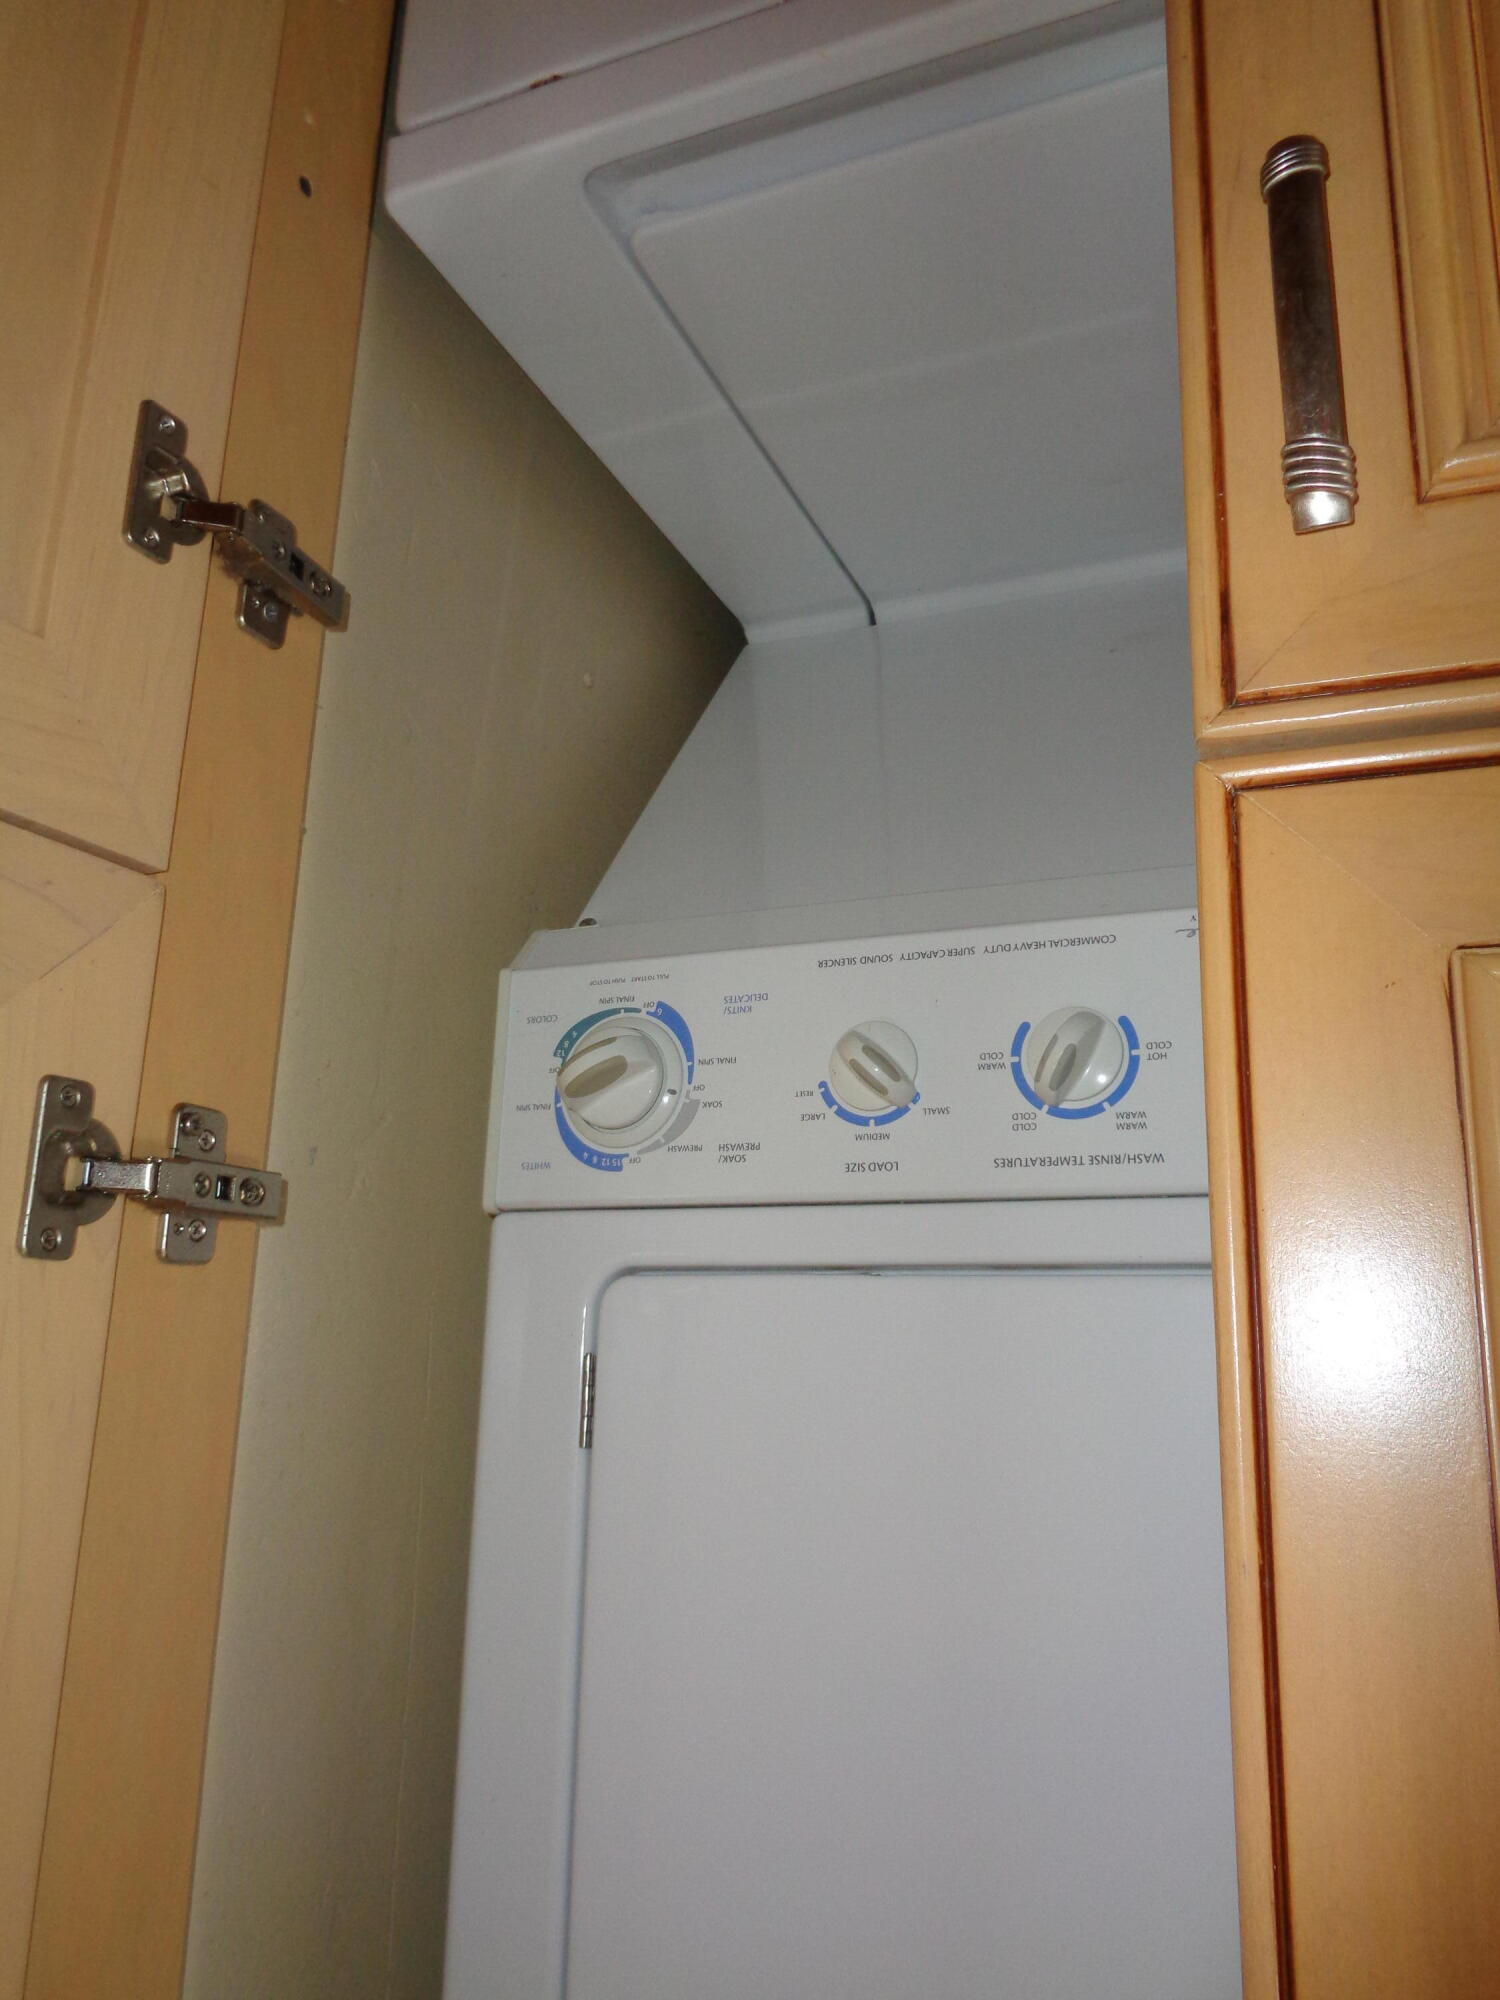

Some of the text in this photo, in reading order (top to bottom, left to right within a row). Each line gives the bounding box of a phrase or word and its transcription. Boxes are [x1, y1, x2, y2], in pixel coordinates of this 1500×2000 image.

[818, 934, 1117, 968] COMMERCIAL HEAVY DUTY SUPER CAPACITY SOUND SILENCER
[599, 995, 635, 1005] FINAL SPIN
[723, 992, 769, 1004] DELICATES
[643, 1001, 655, 1009] OFF
[723, 1005, 752, 1015] KNITS/
[526, 1013, 558, 1025] COLORS
[1145, 1040, 1172, 1050] COLD
[698, 1056, 737, 1066] FINAL SPIN
[980, 1051, 1004, 1061] COLD
[1147, 1052, 1167, 1061] HOT
[978, 1062, 1006, 1071] WARM
[693, 1084, 706, 1092] OFF
[795, 1089, 814, 1098] RESET
[516, 1103, 551, 1112] FINAL SPIN
[702, 1100, 723, 1109] SOAK
[922, 1106, 950, 1116] SMALL
[1011, 1111, 1037, 1121] COLD
[1115, 1110, 1147, 1120] WARM
[800, 1112, 826, 1121] LARGE
[1011, 1122, 1037, 1131] COLD
[1116, 1122, 1147, 1131] WARM
[855, 1132, 890, 1142] MEDIUM
[667, 1144, 703, 1153] PREWASH
[718, 1142, 761, 1152] PREWASH
[601, 1158, 611, 1166] 12
[611, 1158, 621, 1166] 15
[629, 1157, 641, 1165] OFF
[718, 1154, 747, 1164] SOAK/
[994, 1152, 1166, 1168] WASH/RINSE TEMPERATURES
[520, 1161, 551, 1171] WHITES
[845, 1161, 899, 1173] LOAD SIZE
